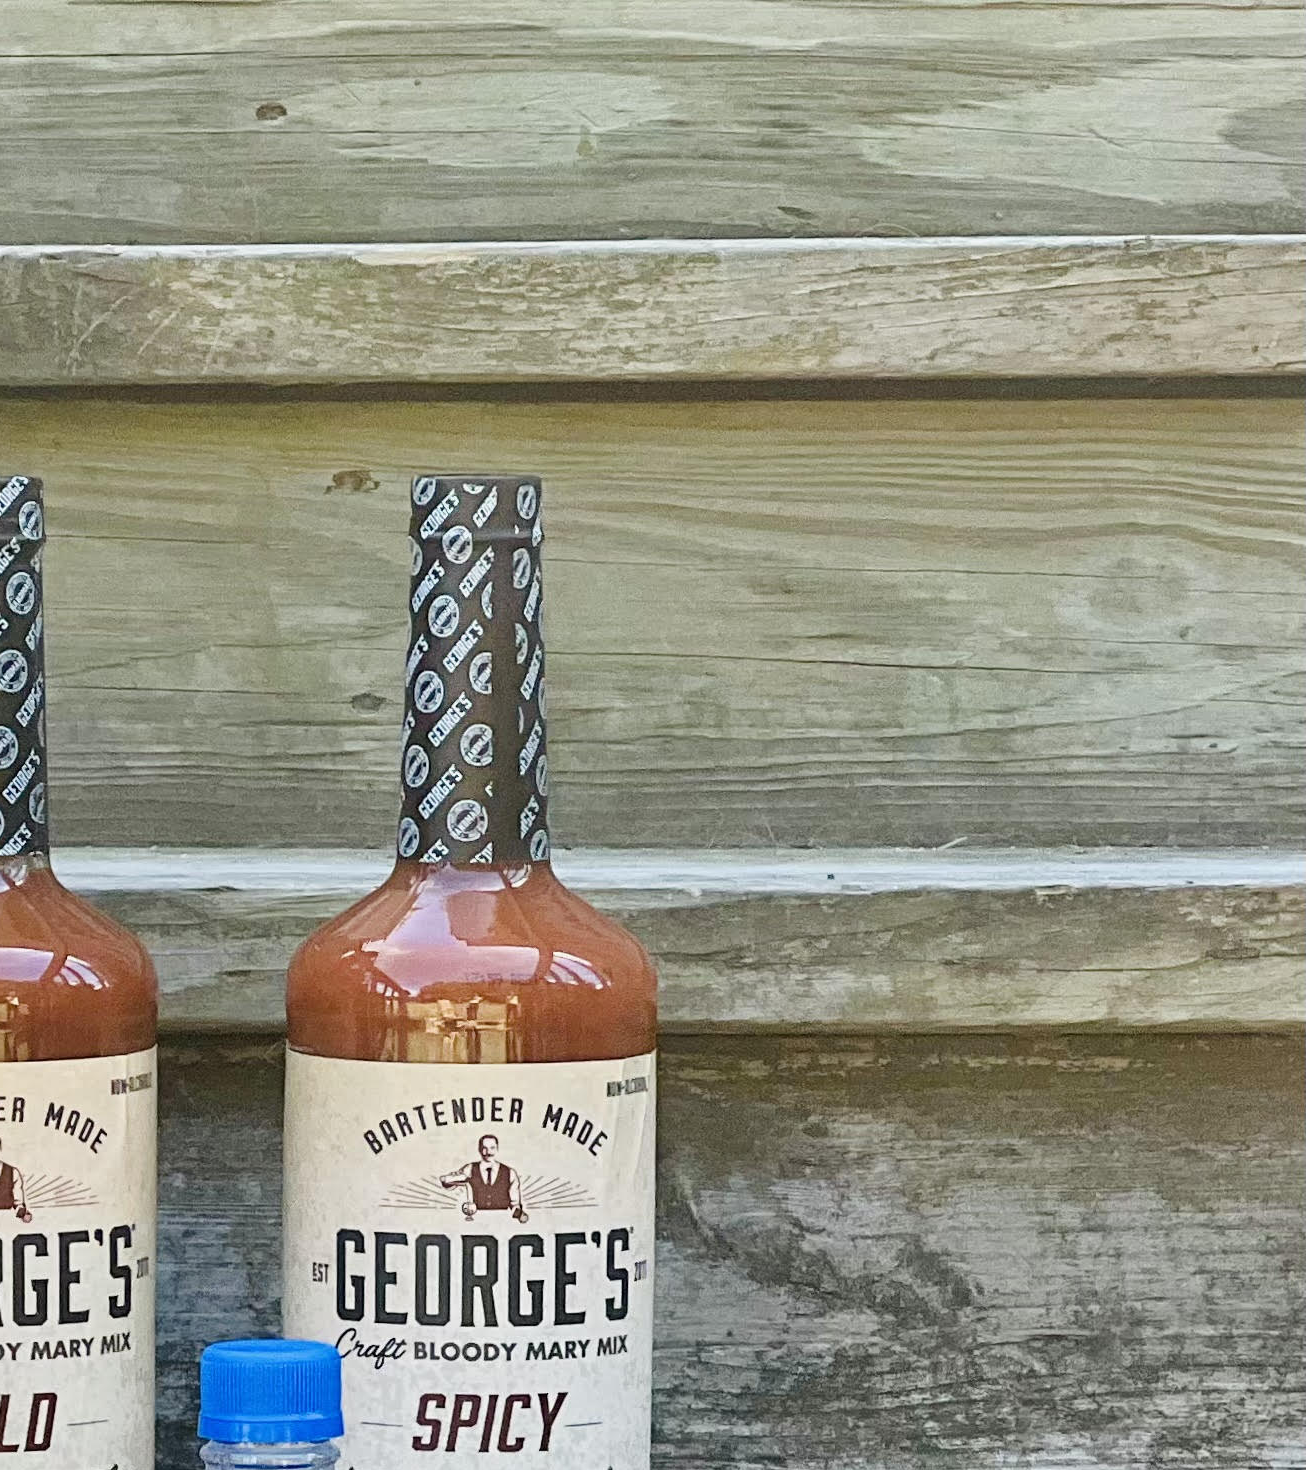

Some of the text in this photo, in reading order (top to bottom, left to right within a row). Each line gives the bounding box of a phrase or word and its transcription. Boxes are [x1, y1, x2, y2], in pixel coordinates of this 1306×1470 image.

[44, 1101, 108, 1154] MADE
[363, 1097, 608, 1157] BARTENDER MADE
[312, 1228, 630, 1328] EST GEORGE'S
[30, 1338, 94, 1361] MARY
[100, 1331, 131, 1354] MIX
[335, 1328, 628, 1370] Craft BLOODY MARY MIX
[411, 1392, 568, 1453] SPICY
